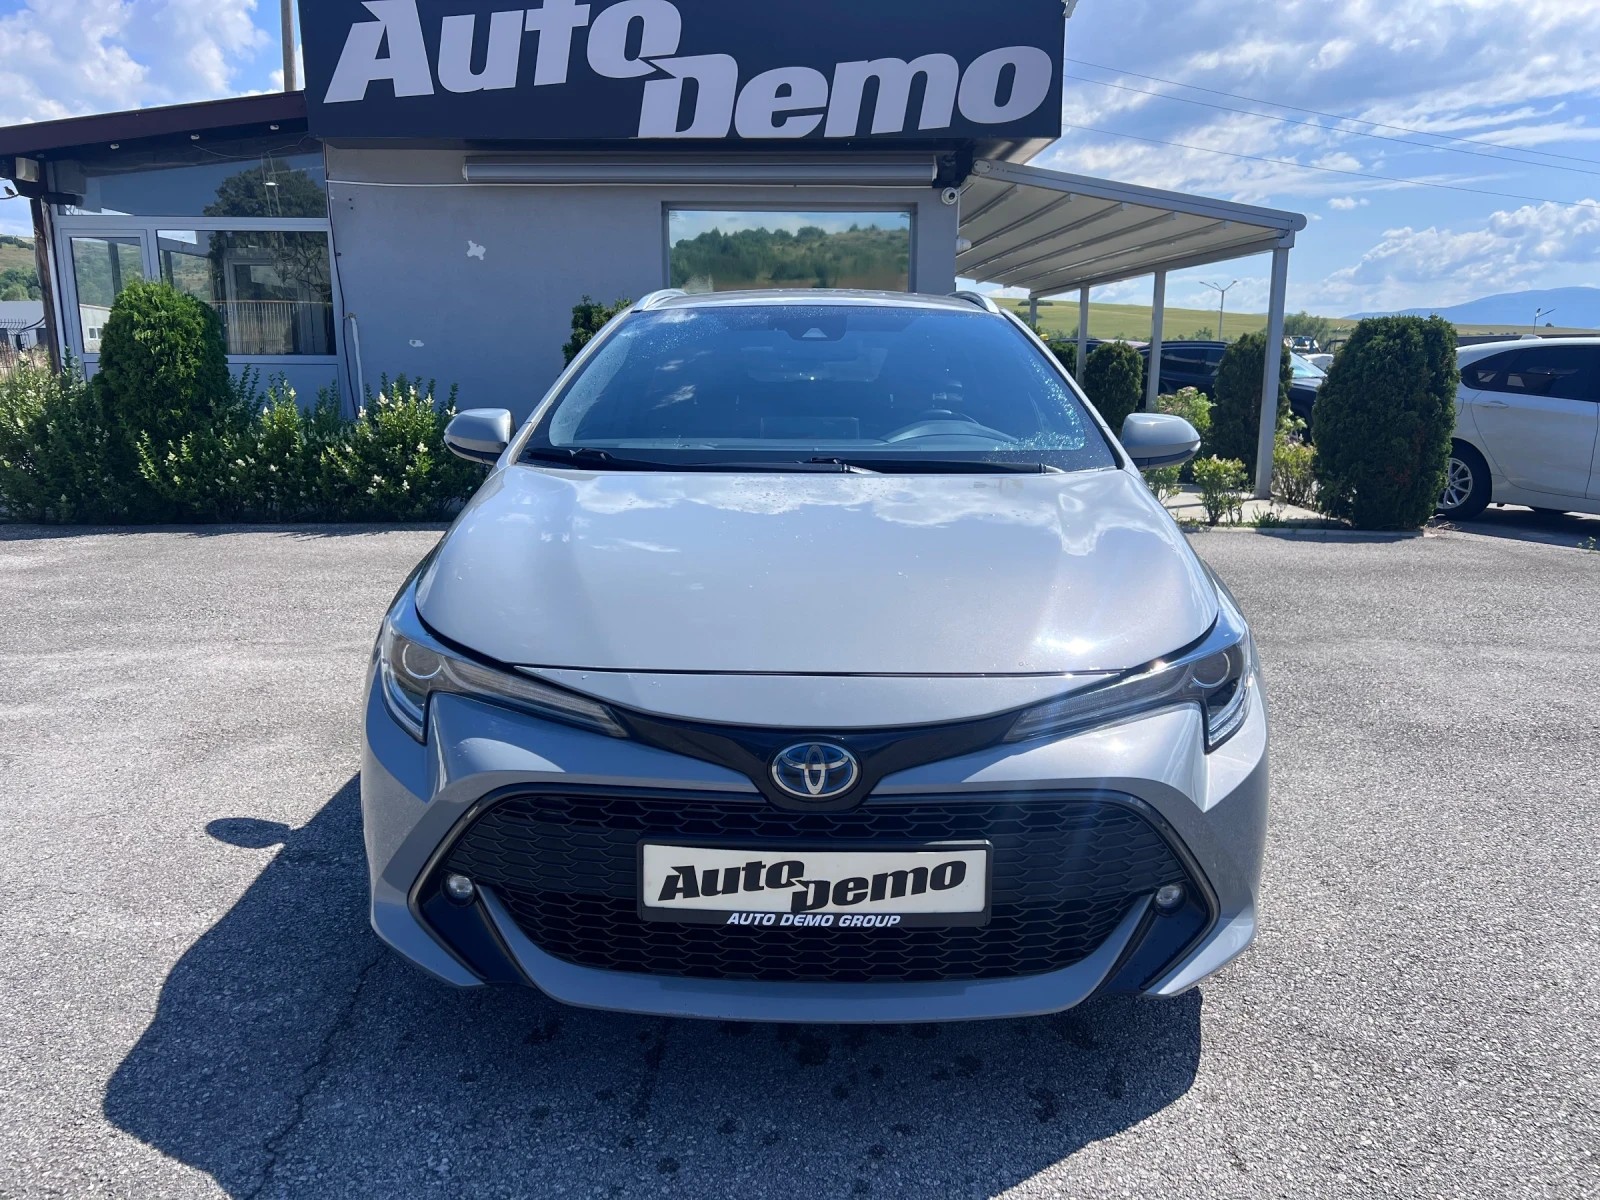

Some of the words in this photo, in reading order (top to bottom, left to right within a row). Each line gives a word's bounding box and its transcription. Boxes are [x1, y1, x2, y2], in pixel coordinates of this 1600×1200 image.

[323, 0, 682, 104] Auto
[637, 45, 1052, 139] Demo
[657, 860, 805, 902] Auto
[790, 860, 967, 913] Demo
[727, 912, 775, 926] AUTO
[780, 913, 834, 927] DEMO
[838, 914, 901, 928] GROUP
